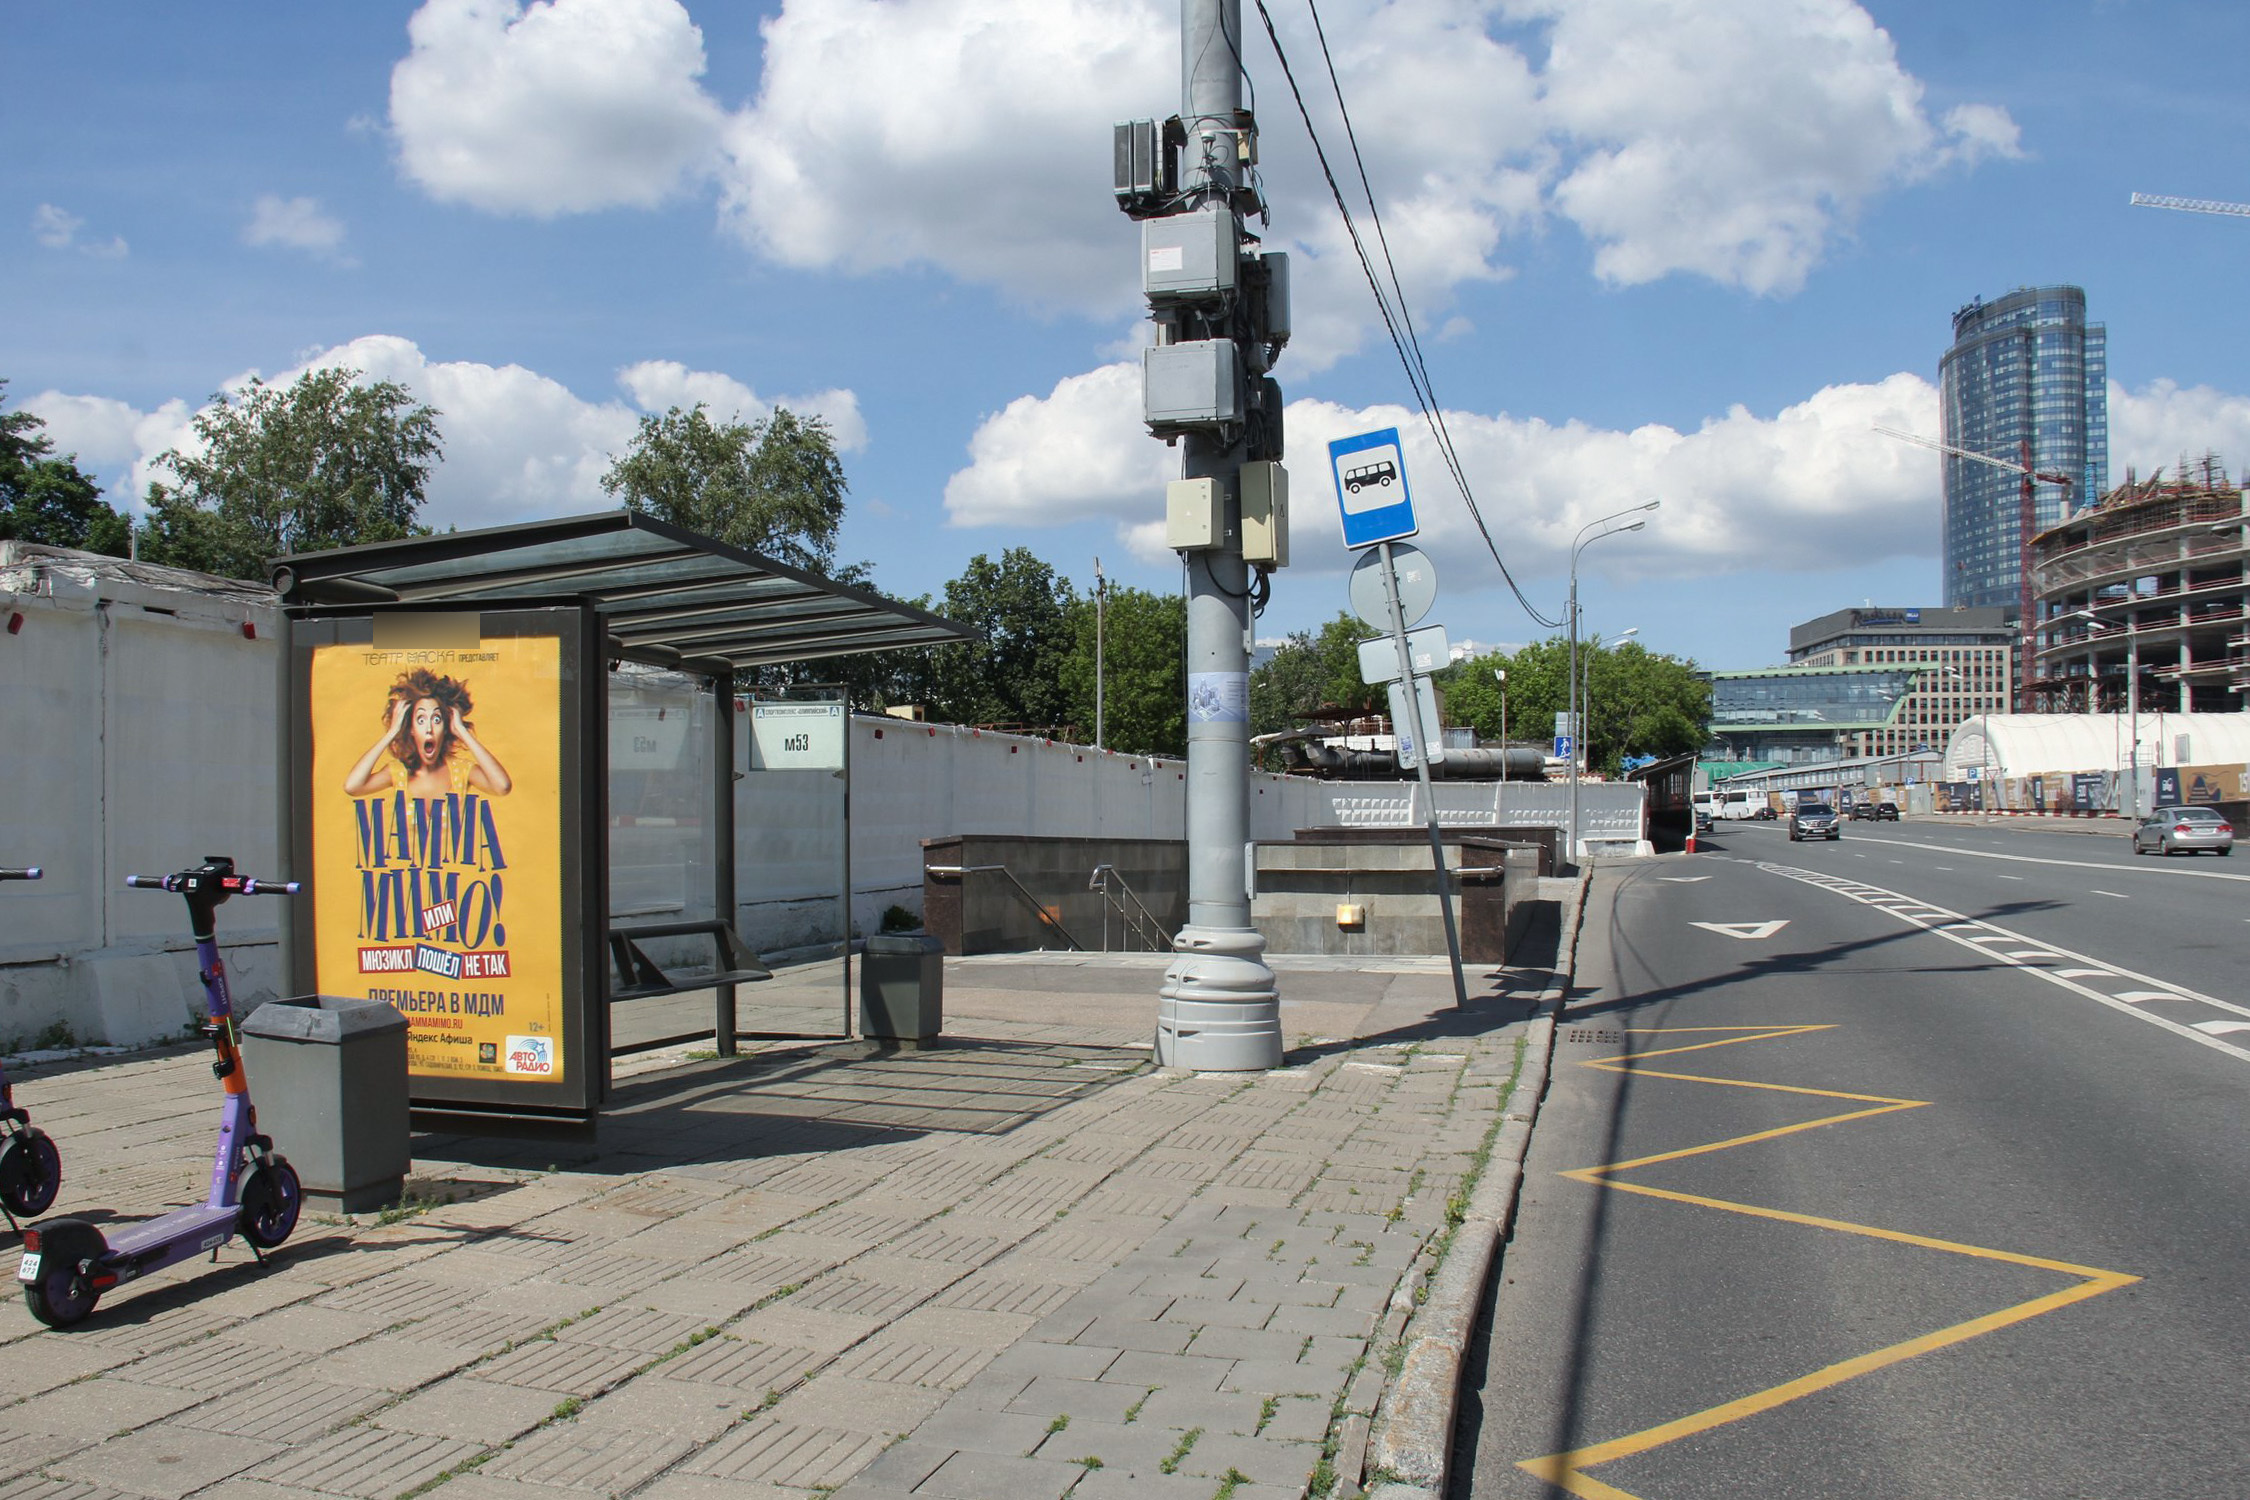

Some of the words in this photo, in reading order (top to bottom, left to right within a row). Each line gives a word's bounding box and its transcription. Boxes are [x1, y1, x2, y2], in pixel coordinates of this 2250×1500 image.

[362, 653, 403, 665] ТЕАТР
[407, 651, 455, 664] МАСКА
[353, 789, 508, 873] МАММА
[357, 867, 506, 950] МИМО!
[423, 902, 456, 930] ИЛИ
[362, 949, 413, 971] МЮЗИКЛ
[417, 947, 460, 977] ПОШЁЛ
[465, 955, 481, 976] НЕ
[482, 954, 507, 975] ТАК
[451, 992, 460, 1013] В
[464, 993, 504, 1017] МДМ
[529, 1022, 545, 1032] 12+
[407, 1031, 438, 1043] Яндекс
[440, 1033, 473, 1045] Афиша
[509, 1051, 536, 1062] АВТО
[516, 1061, 550, 1072] РАДИО
